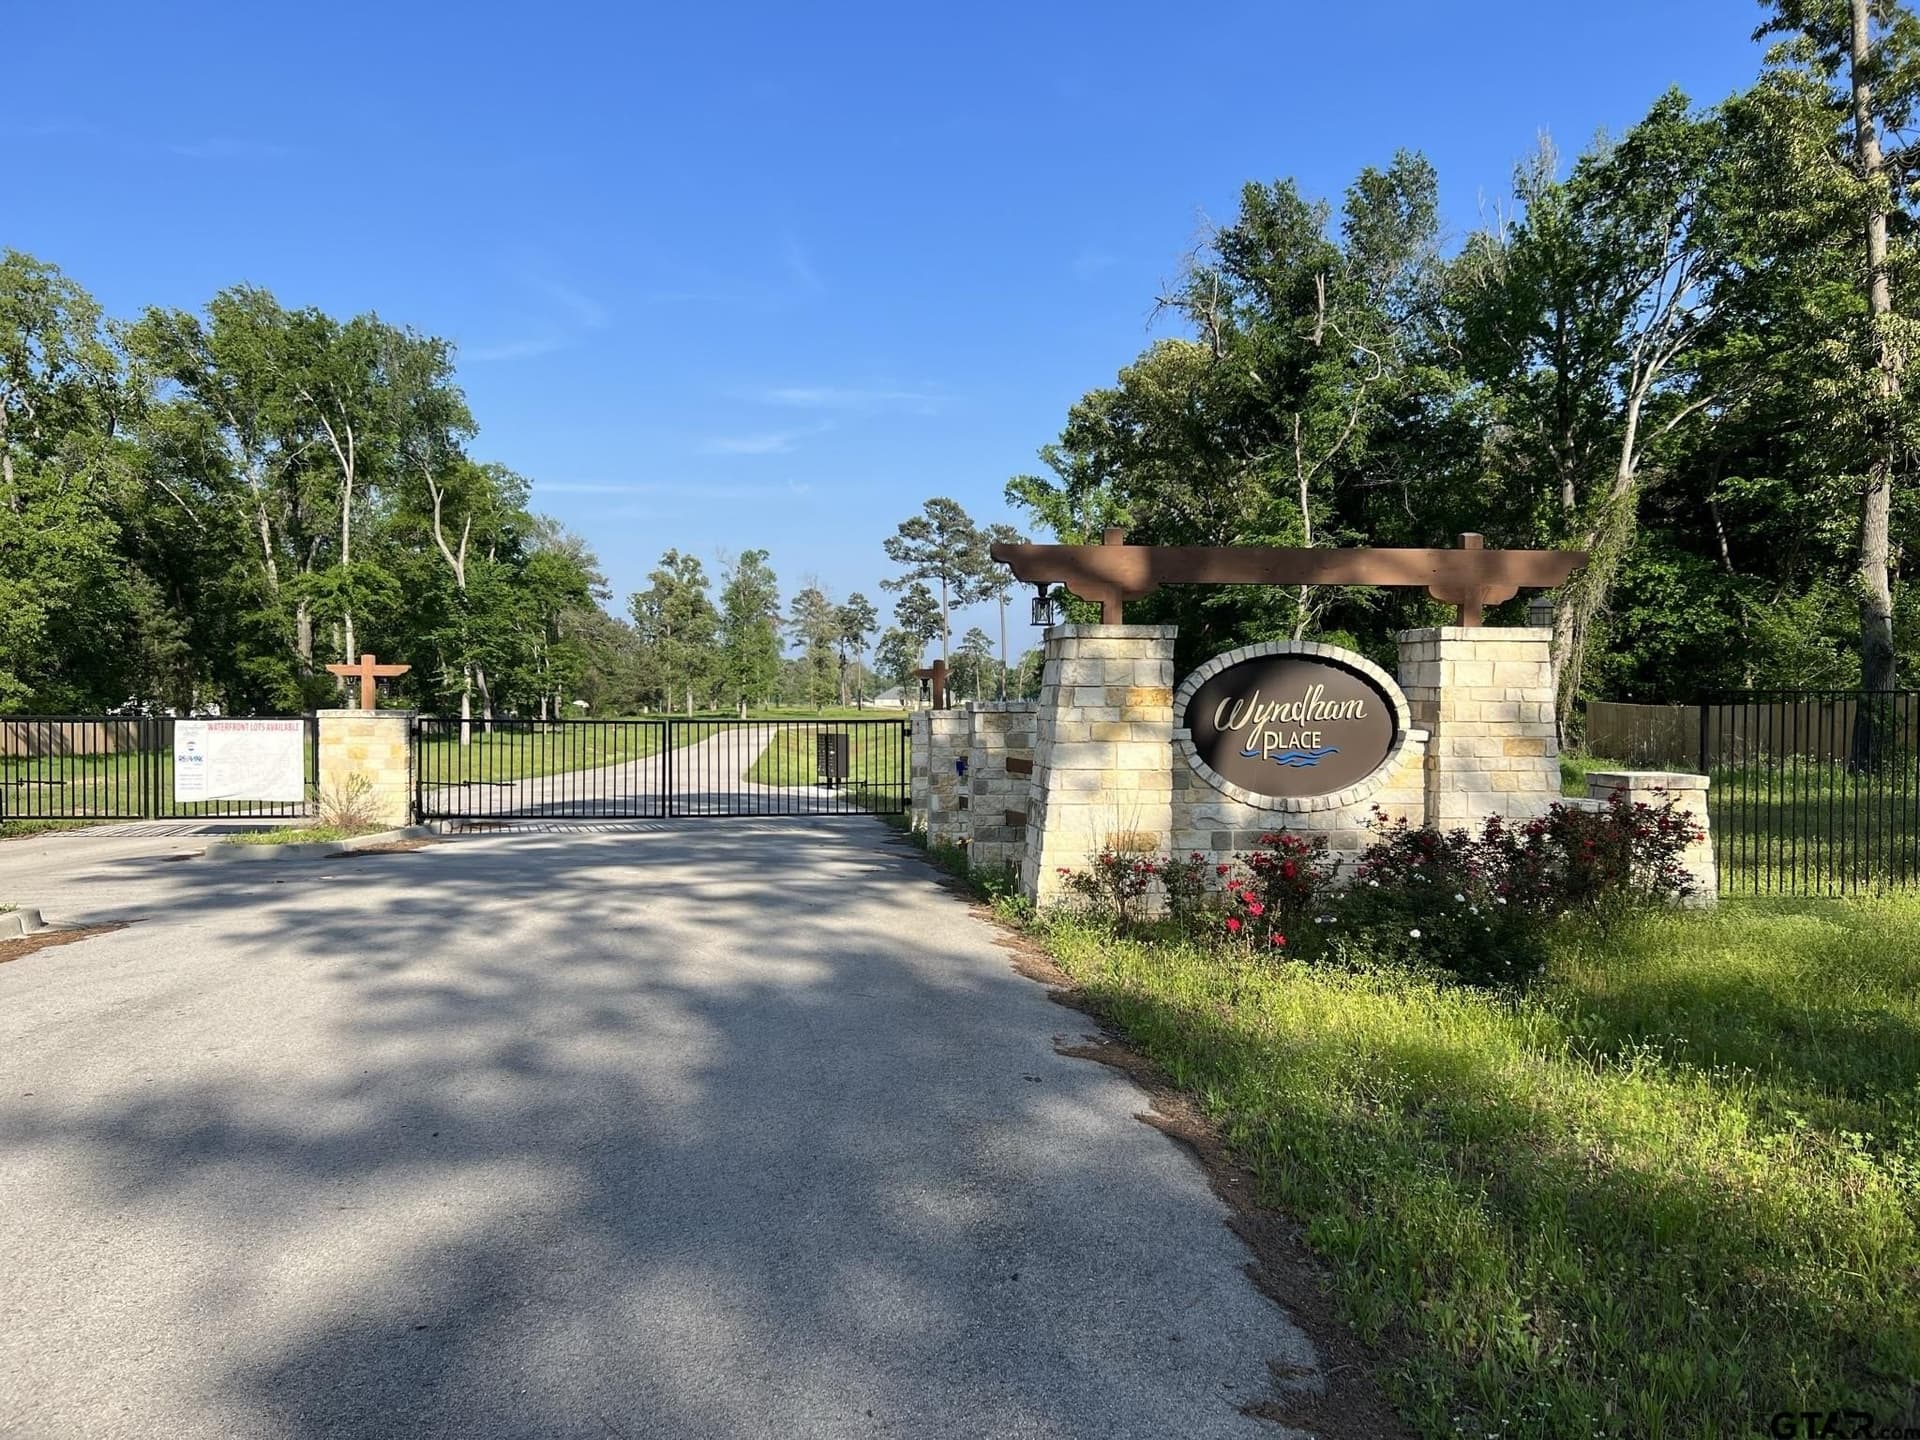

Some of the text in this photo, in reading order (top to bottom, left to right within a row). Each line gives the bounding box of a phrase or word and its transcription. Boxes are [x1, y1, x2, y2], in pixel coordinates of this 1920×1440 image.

[207, 722, 249, 732] WATERFRONT
[250, 722, 266, 732] LOTS
[266, 722, 299, 732] AVAILABLE
[1213, 683, 1368, 751] Wyndham
[1263, 731, 1322, 760] PLACE
